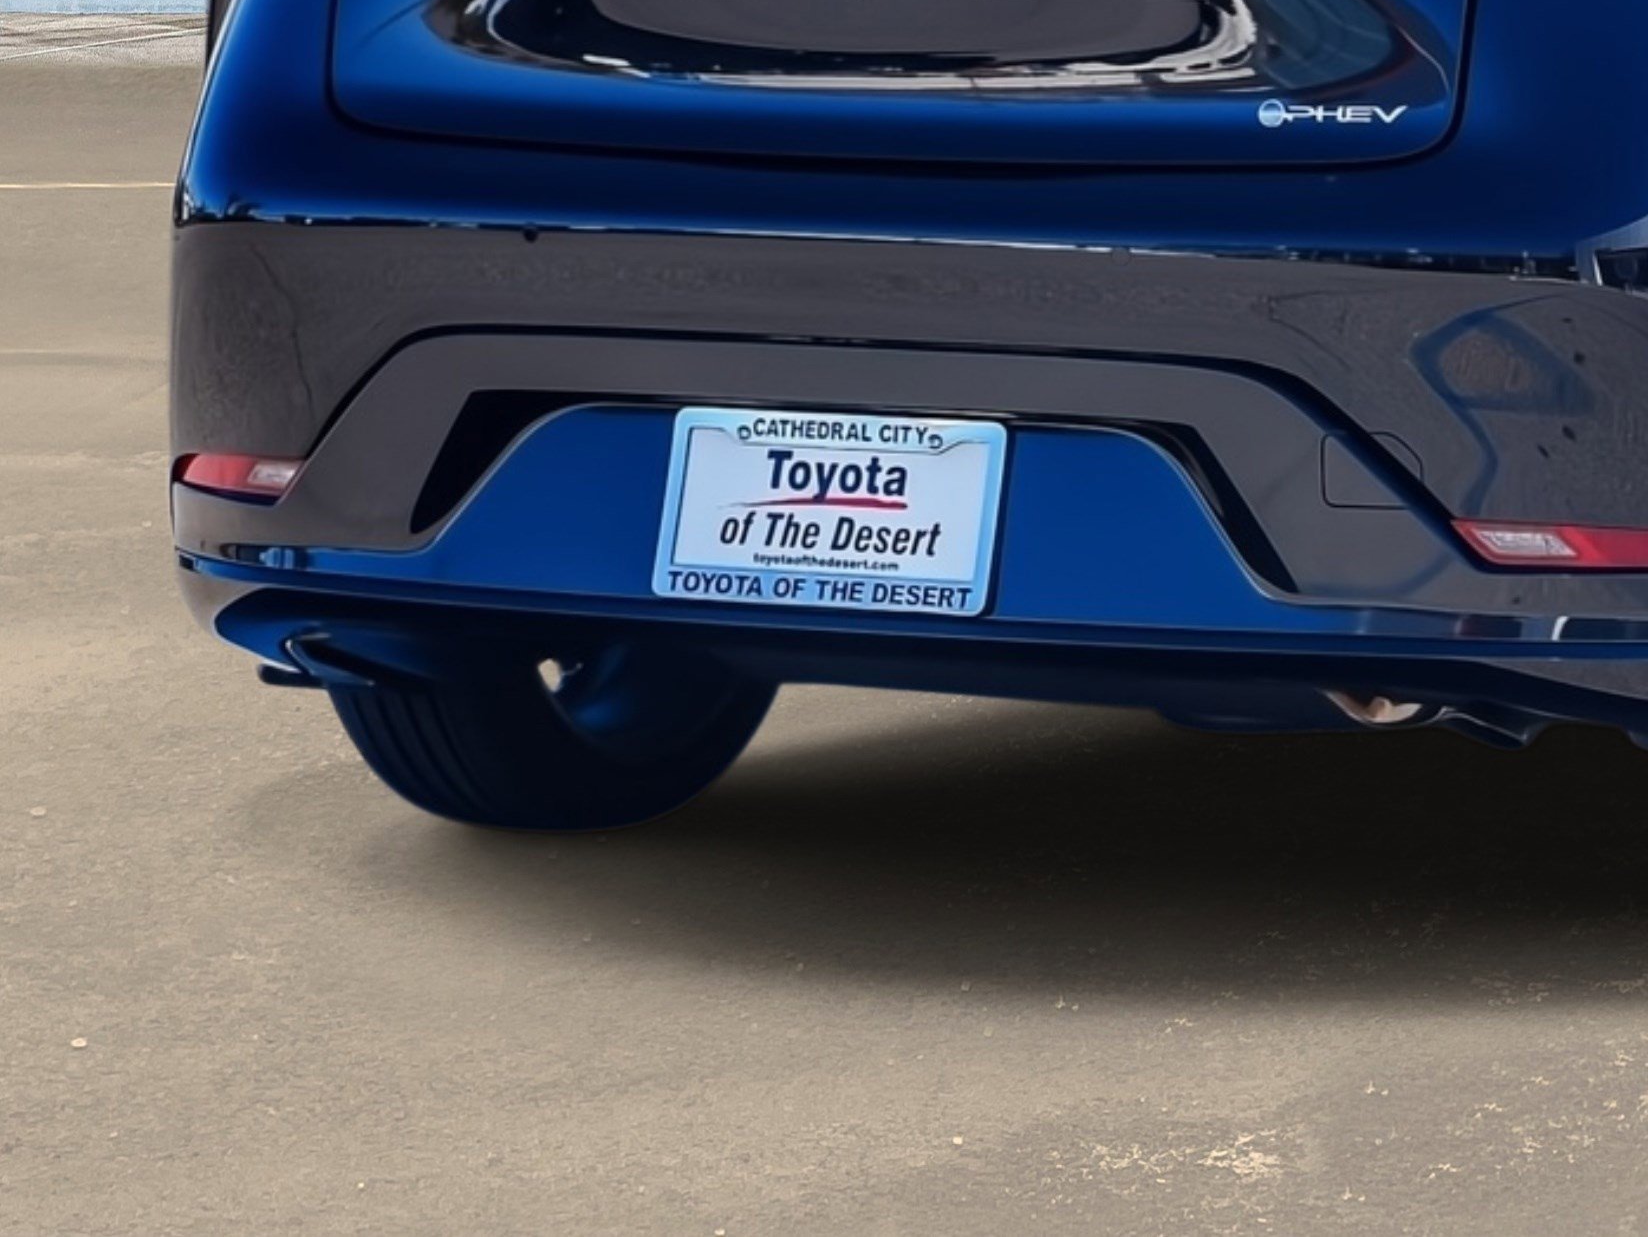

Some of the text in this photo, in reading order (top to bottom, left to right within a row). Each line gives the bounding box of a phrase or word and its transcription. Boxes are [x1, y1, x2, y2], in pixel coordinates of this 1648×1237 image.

[752, 417, 929, 445] CATHEDRAL CITY
[767, 449, 908, 503] Toyota
[720, 510, 942, 558] of The Desert
[753, 552, 900, 572] toyotaofthedesert.com
[668, 570, 973, 610] TOYOTA OF THE DESERT
